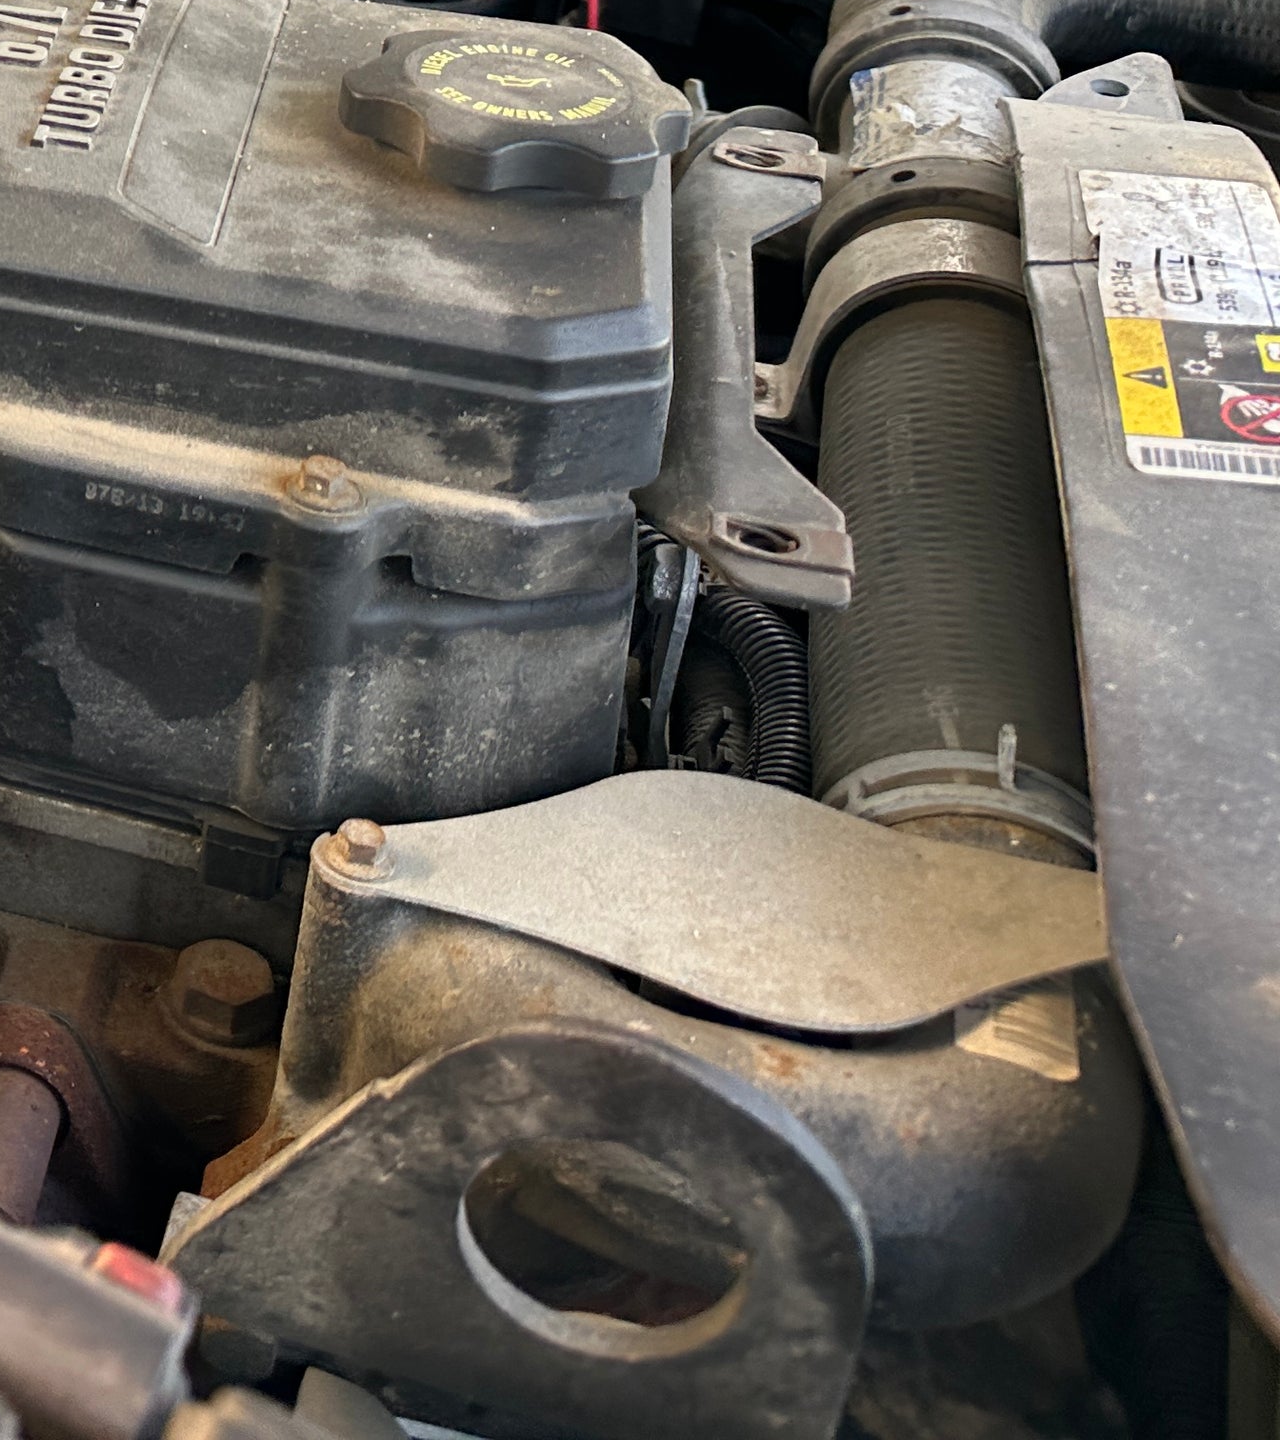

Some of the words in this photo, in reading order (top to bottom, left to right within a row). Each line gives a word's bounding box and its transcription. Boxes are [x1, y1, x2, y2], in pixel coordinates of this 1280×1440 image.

[419, 48, 464, 76] DIESEL
[459, 44, 539, 57] ENGINE
[544, 52, 576, 69] OIL
[29, 46, 126, 151] TURBO
[434, 85, 473, 104] SEE
[558, 95, 617, 121] MANUAL
